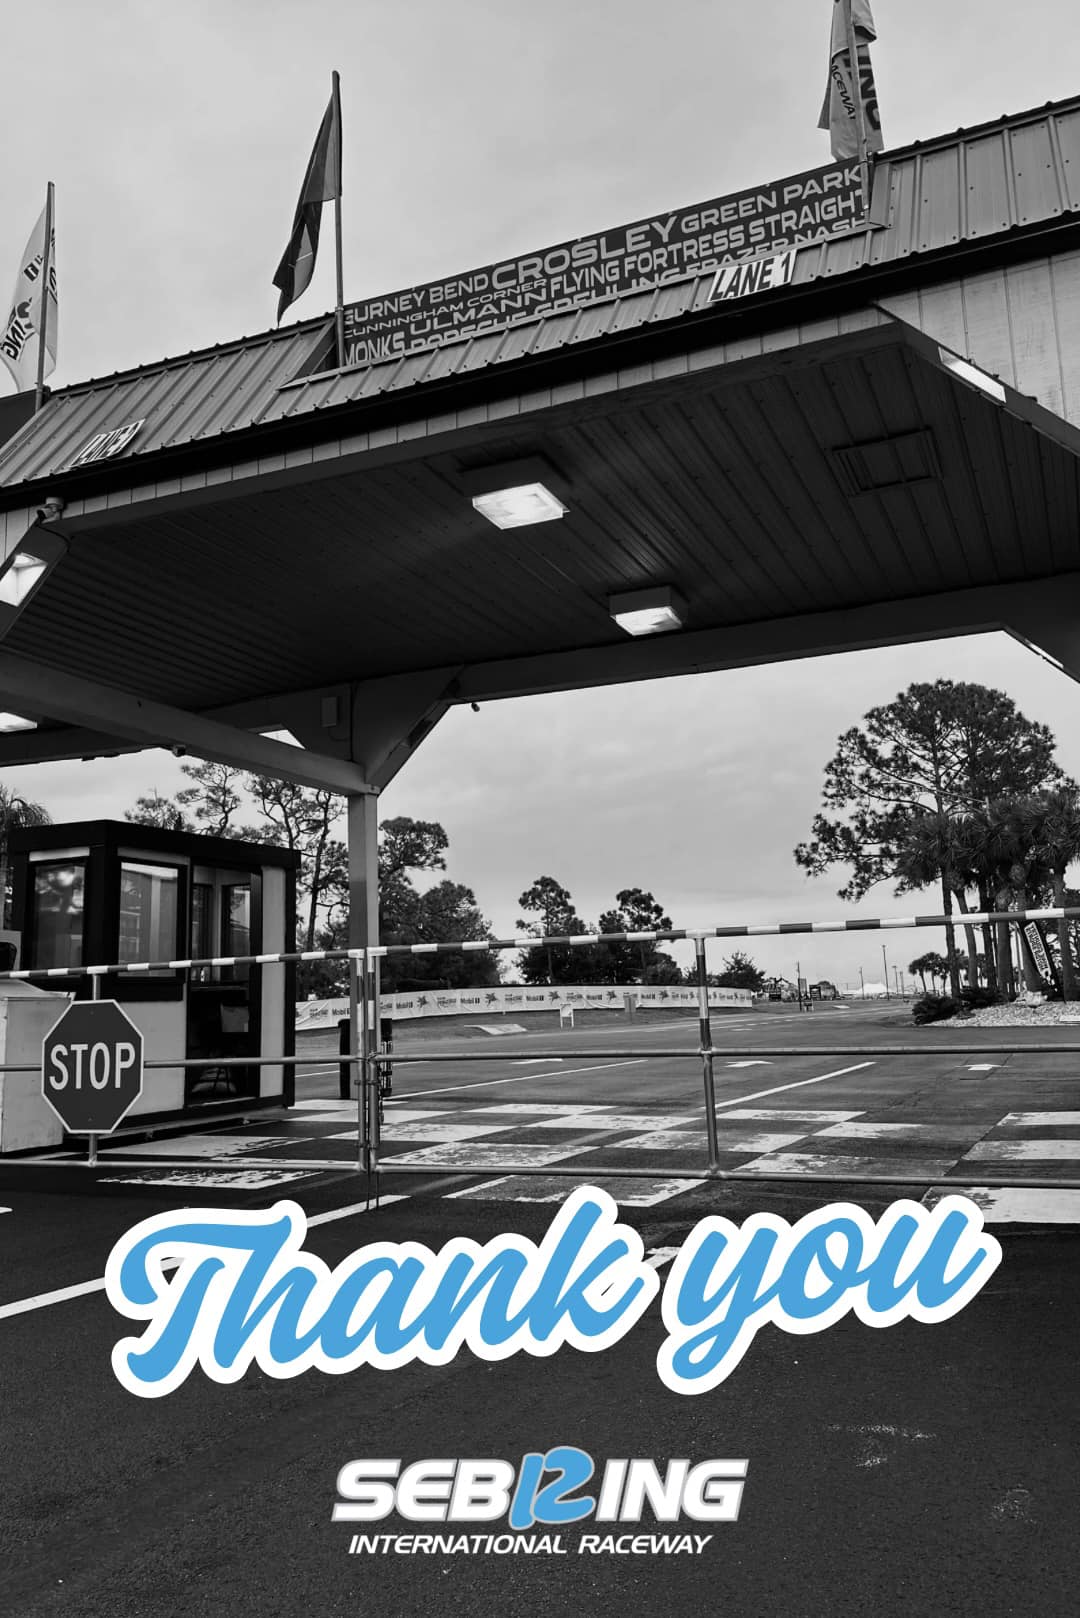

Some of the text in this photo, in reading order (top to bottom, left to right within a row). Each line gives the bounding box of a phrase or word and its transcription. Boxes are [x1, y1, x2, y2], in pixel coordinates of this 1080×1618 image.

[680, 164, 862, 234] GREEN PARK
[491, 215, 678, 290] CROSLEY
[550, 259, 620, 299] FLYING
[624, 224, 745, 278] FORTRESS
[709, 256, 776, 301] LANE
[780, 250, 792, 284] 1
[344, 273, 489, 326] GURNEY BEND
[410, 287, 547, 336] ULMANN
[466, 278, 547, 308] CORNER
[49, 1041, 136, 1091] STOP
